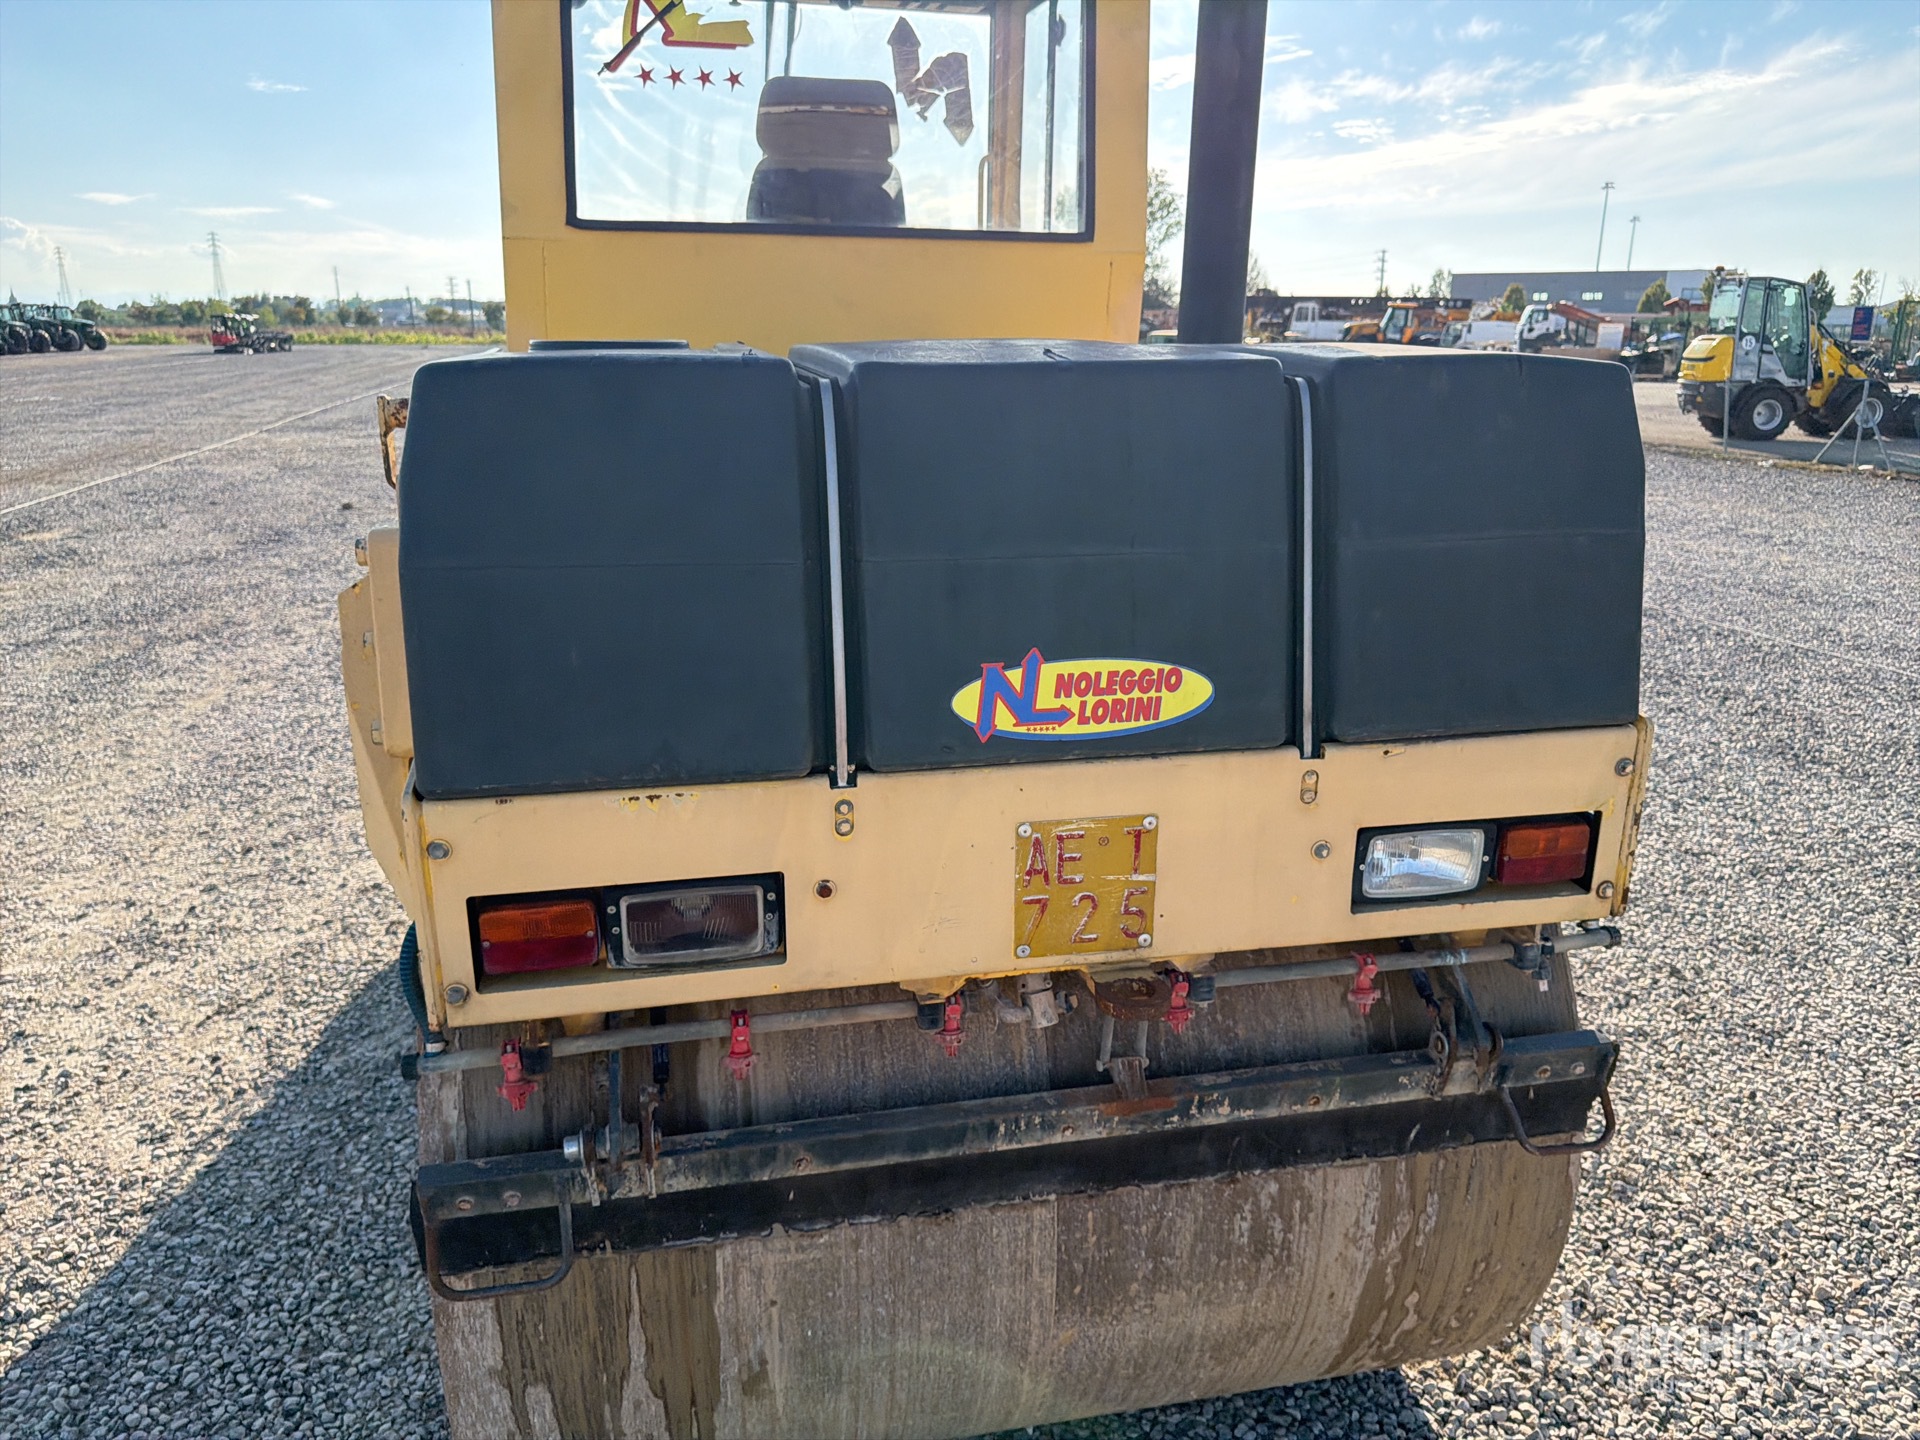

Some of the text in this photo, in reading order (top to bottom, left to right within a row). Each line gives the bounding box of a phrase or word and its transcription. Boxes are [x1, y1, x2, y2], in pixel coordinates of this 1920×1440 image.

[1054, 667, 1183, 699] NOLEGGIO
[1077, 696, 1163, 725] LORINI
[1023, 830, 1086, 887] AE
